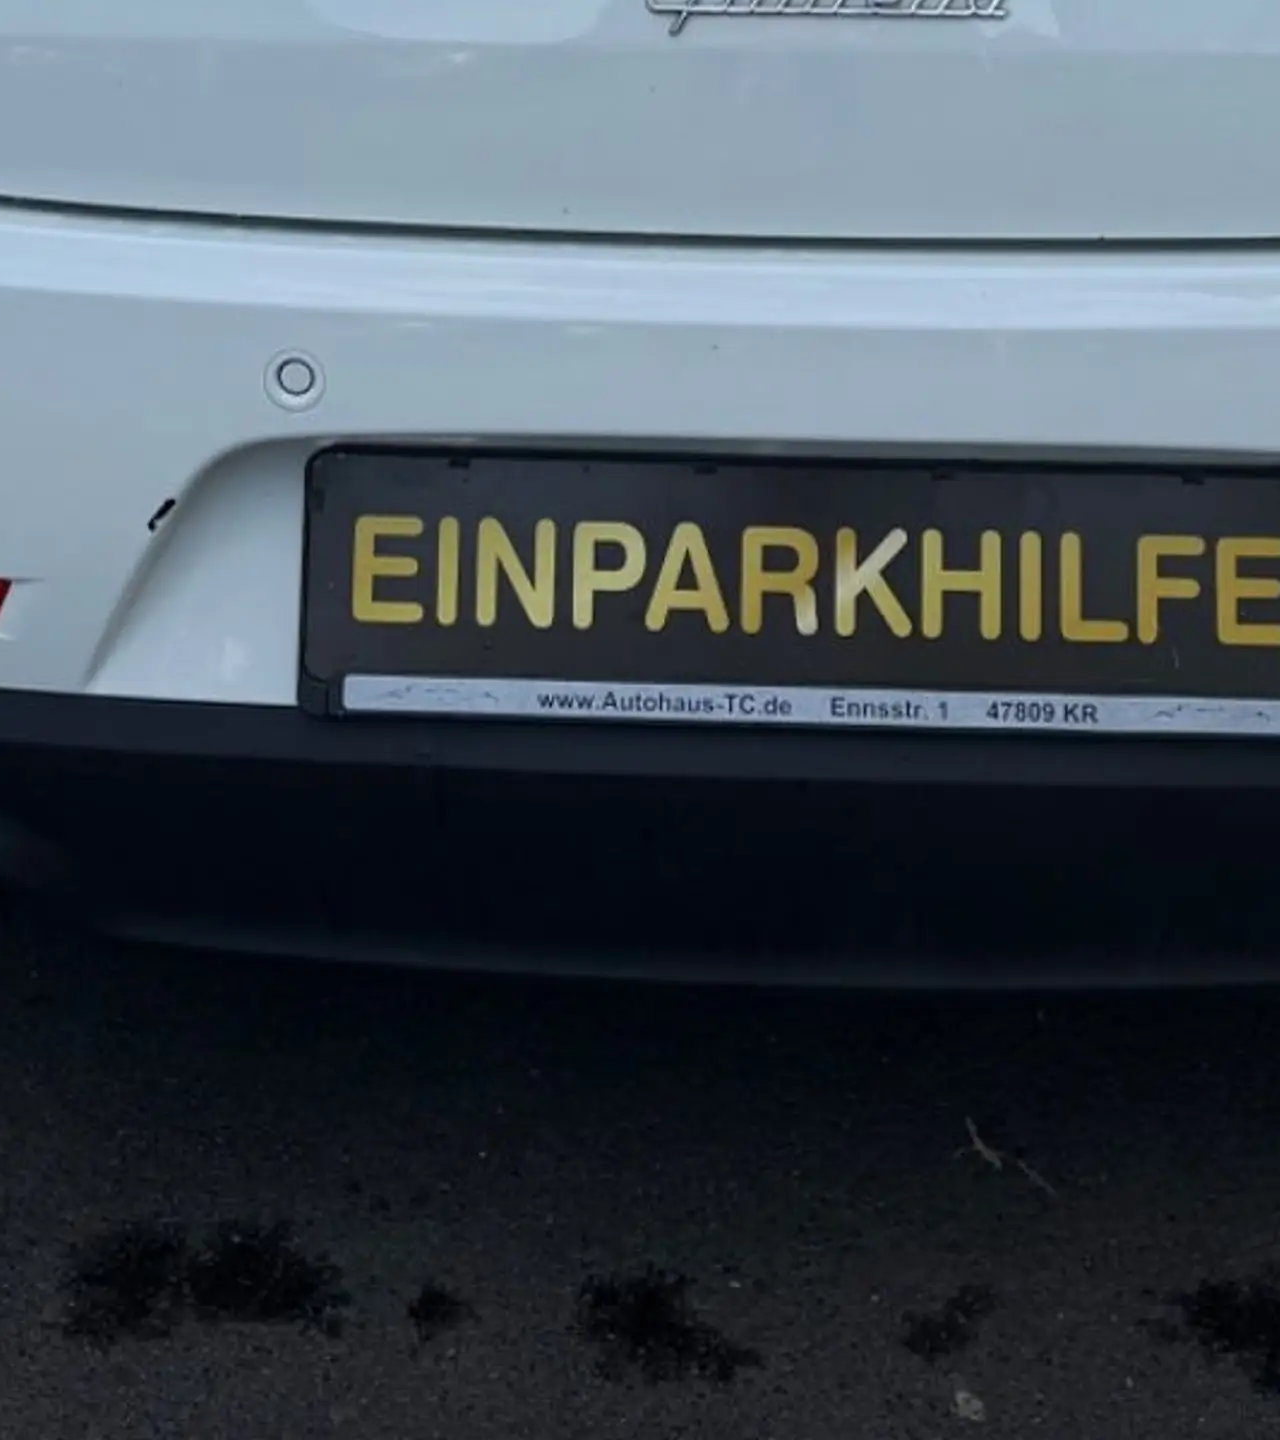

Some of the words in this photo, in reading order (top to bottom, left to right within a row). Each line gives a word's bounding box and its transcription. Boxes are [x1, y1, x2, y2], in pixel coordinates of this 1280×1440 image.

[535, 690, 793, 718] www.Autohaus-TC.de
[937, 701, 950, 721] 1
[985, 701, 1055, 724] 47809
[1062, 702, 1099, 725] KR
